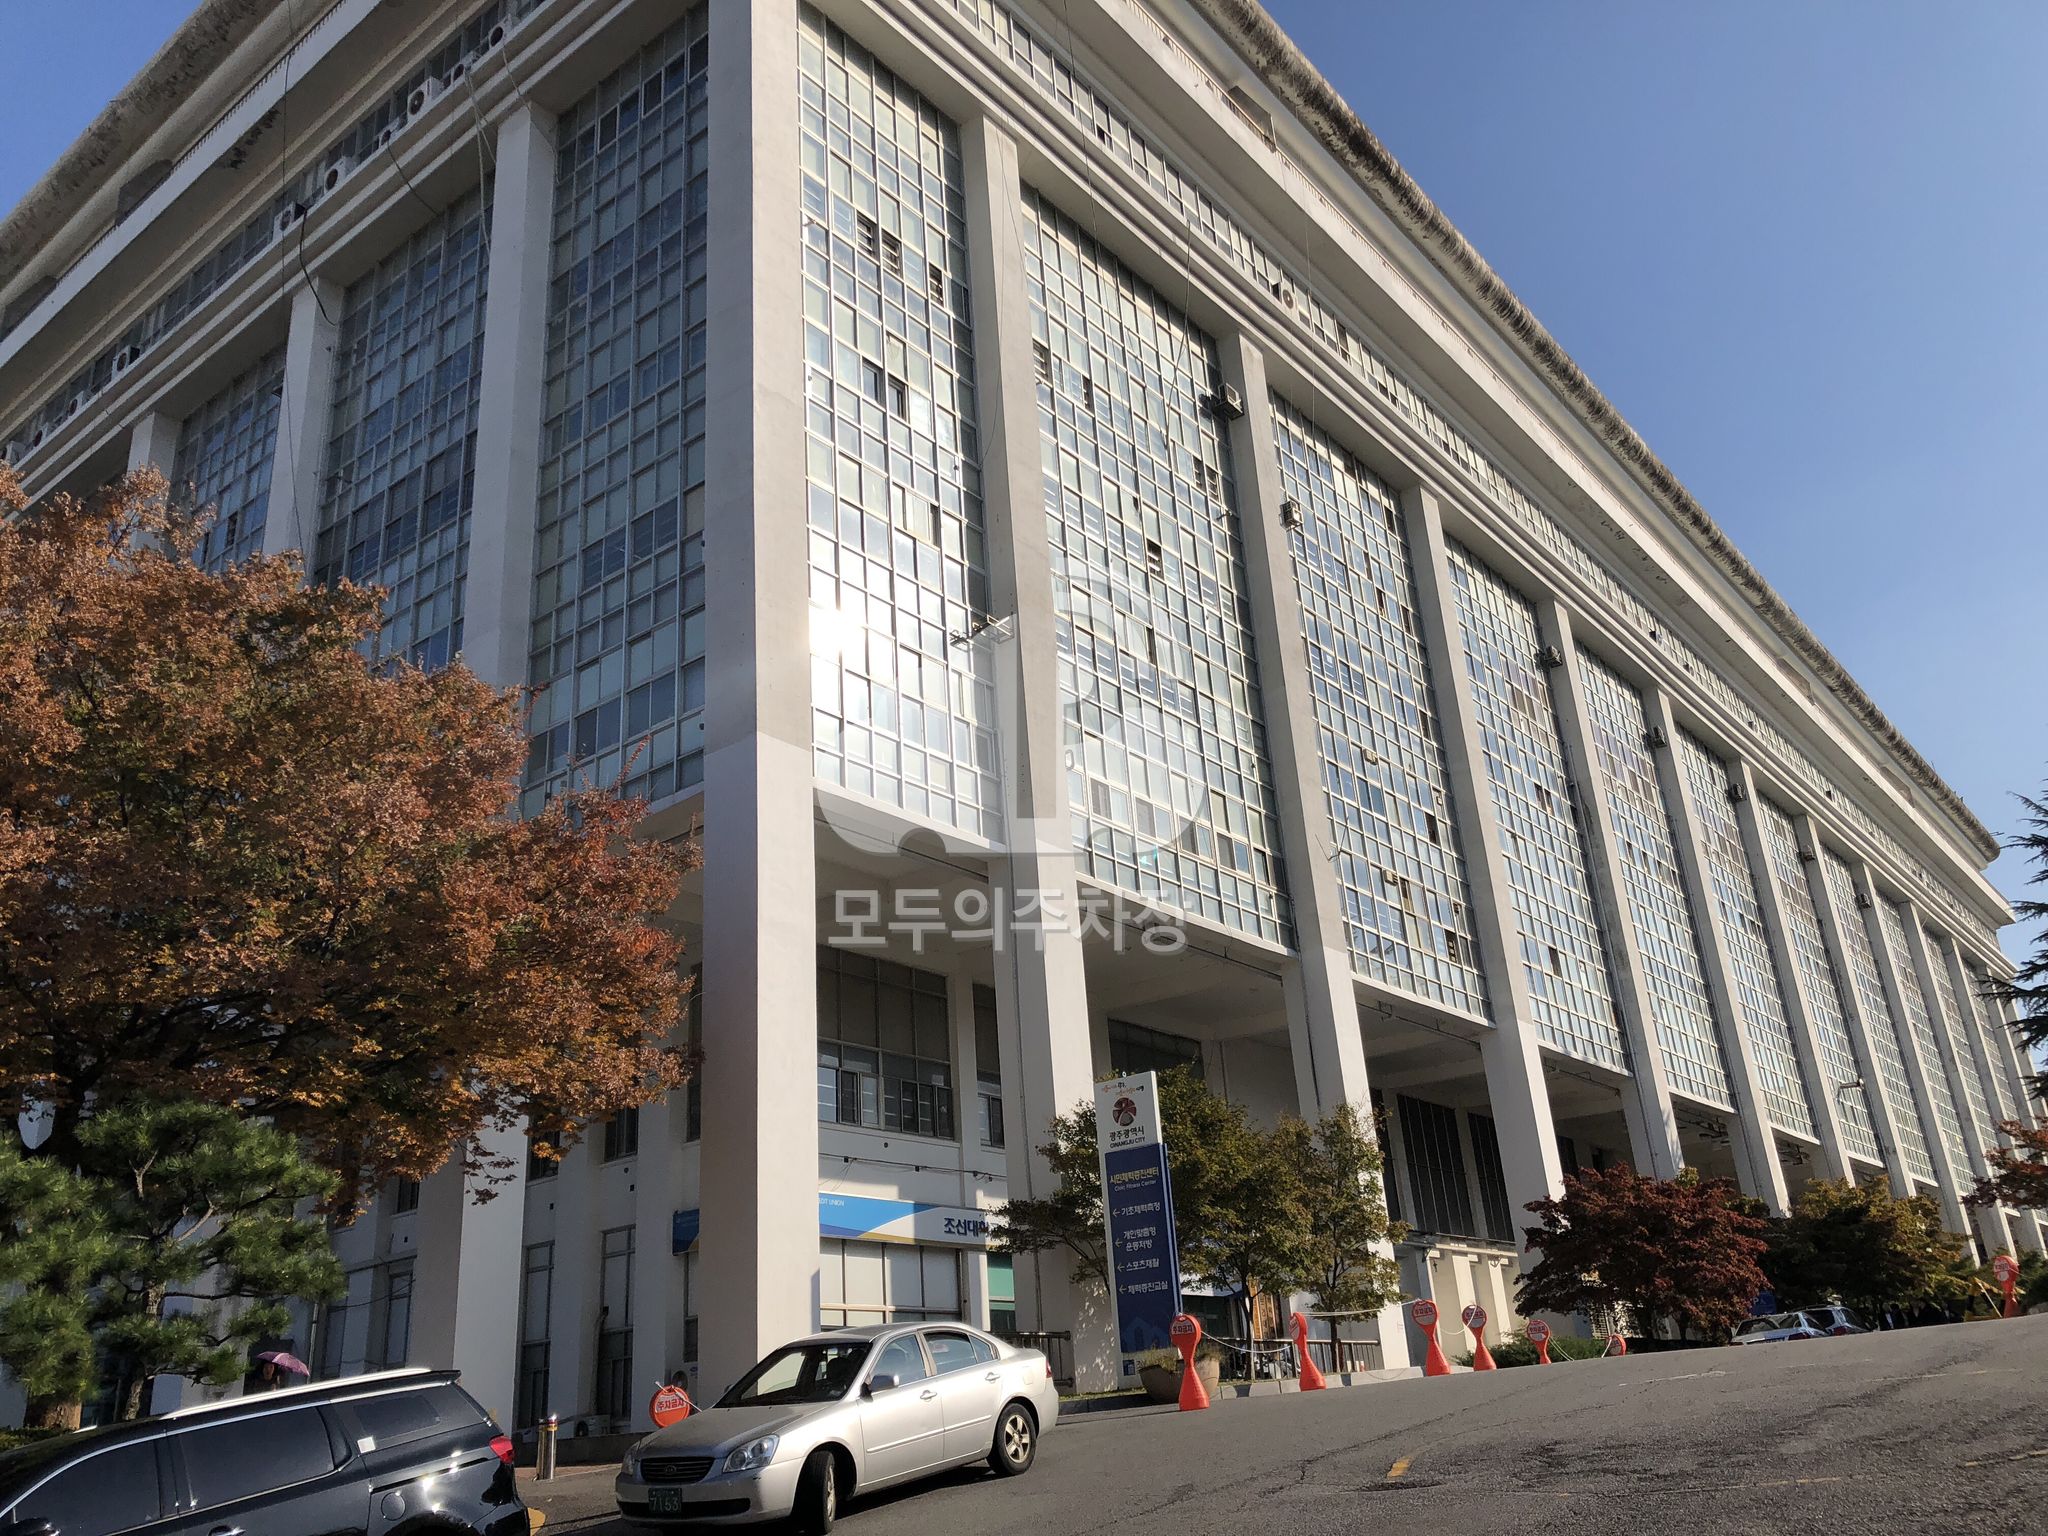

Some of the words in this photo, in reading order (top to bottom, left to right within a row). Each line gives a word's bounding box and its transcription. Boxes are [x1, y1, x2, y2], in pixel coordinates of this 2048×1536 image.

[1109, 1126, 1145, 1141] 광주광역시
[1110, 1138, 1135, 1148] GWANGJU
[1135, 1136, 1146, 1144] CITY
[1126, 1258, 1160, 1272] 스포츠재활
[1128, 1281, 1168, 1295] 체력증진교실
